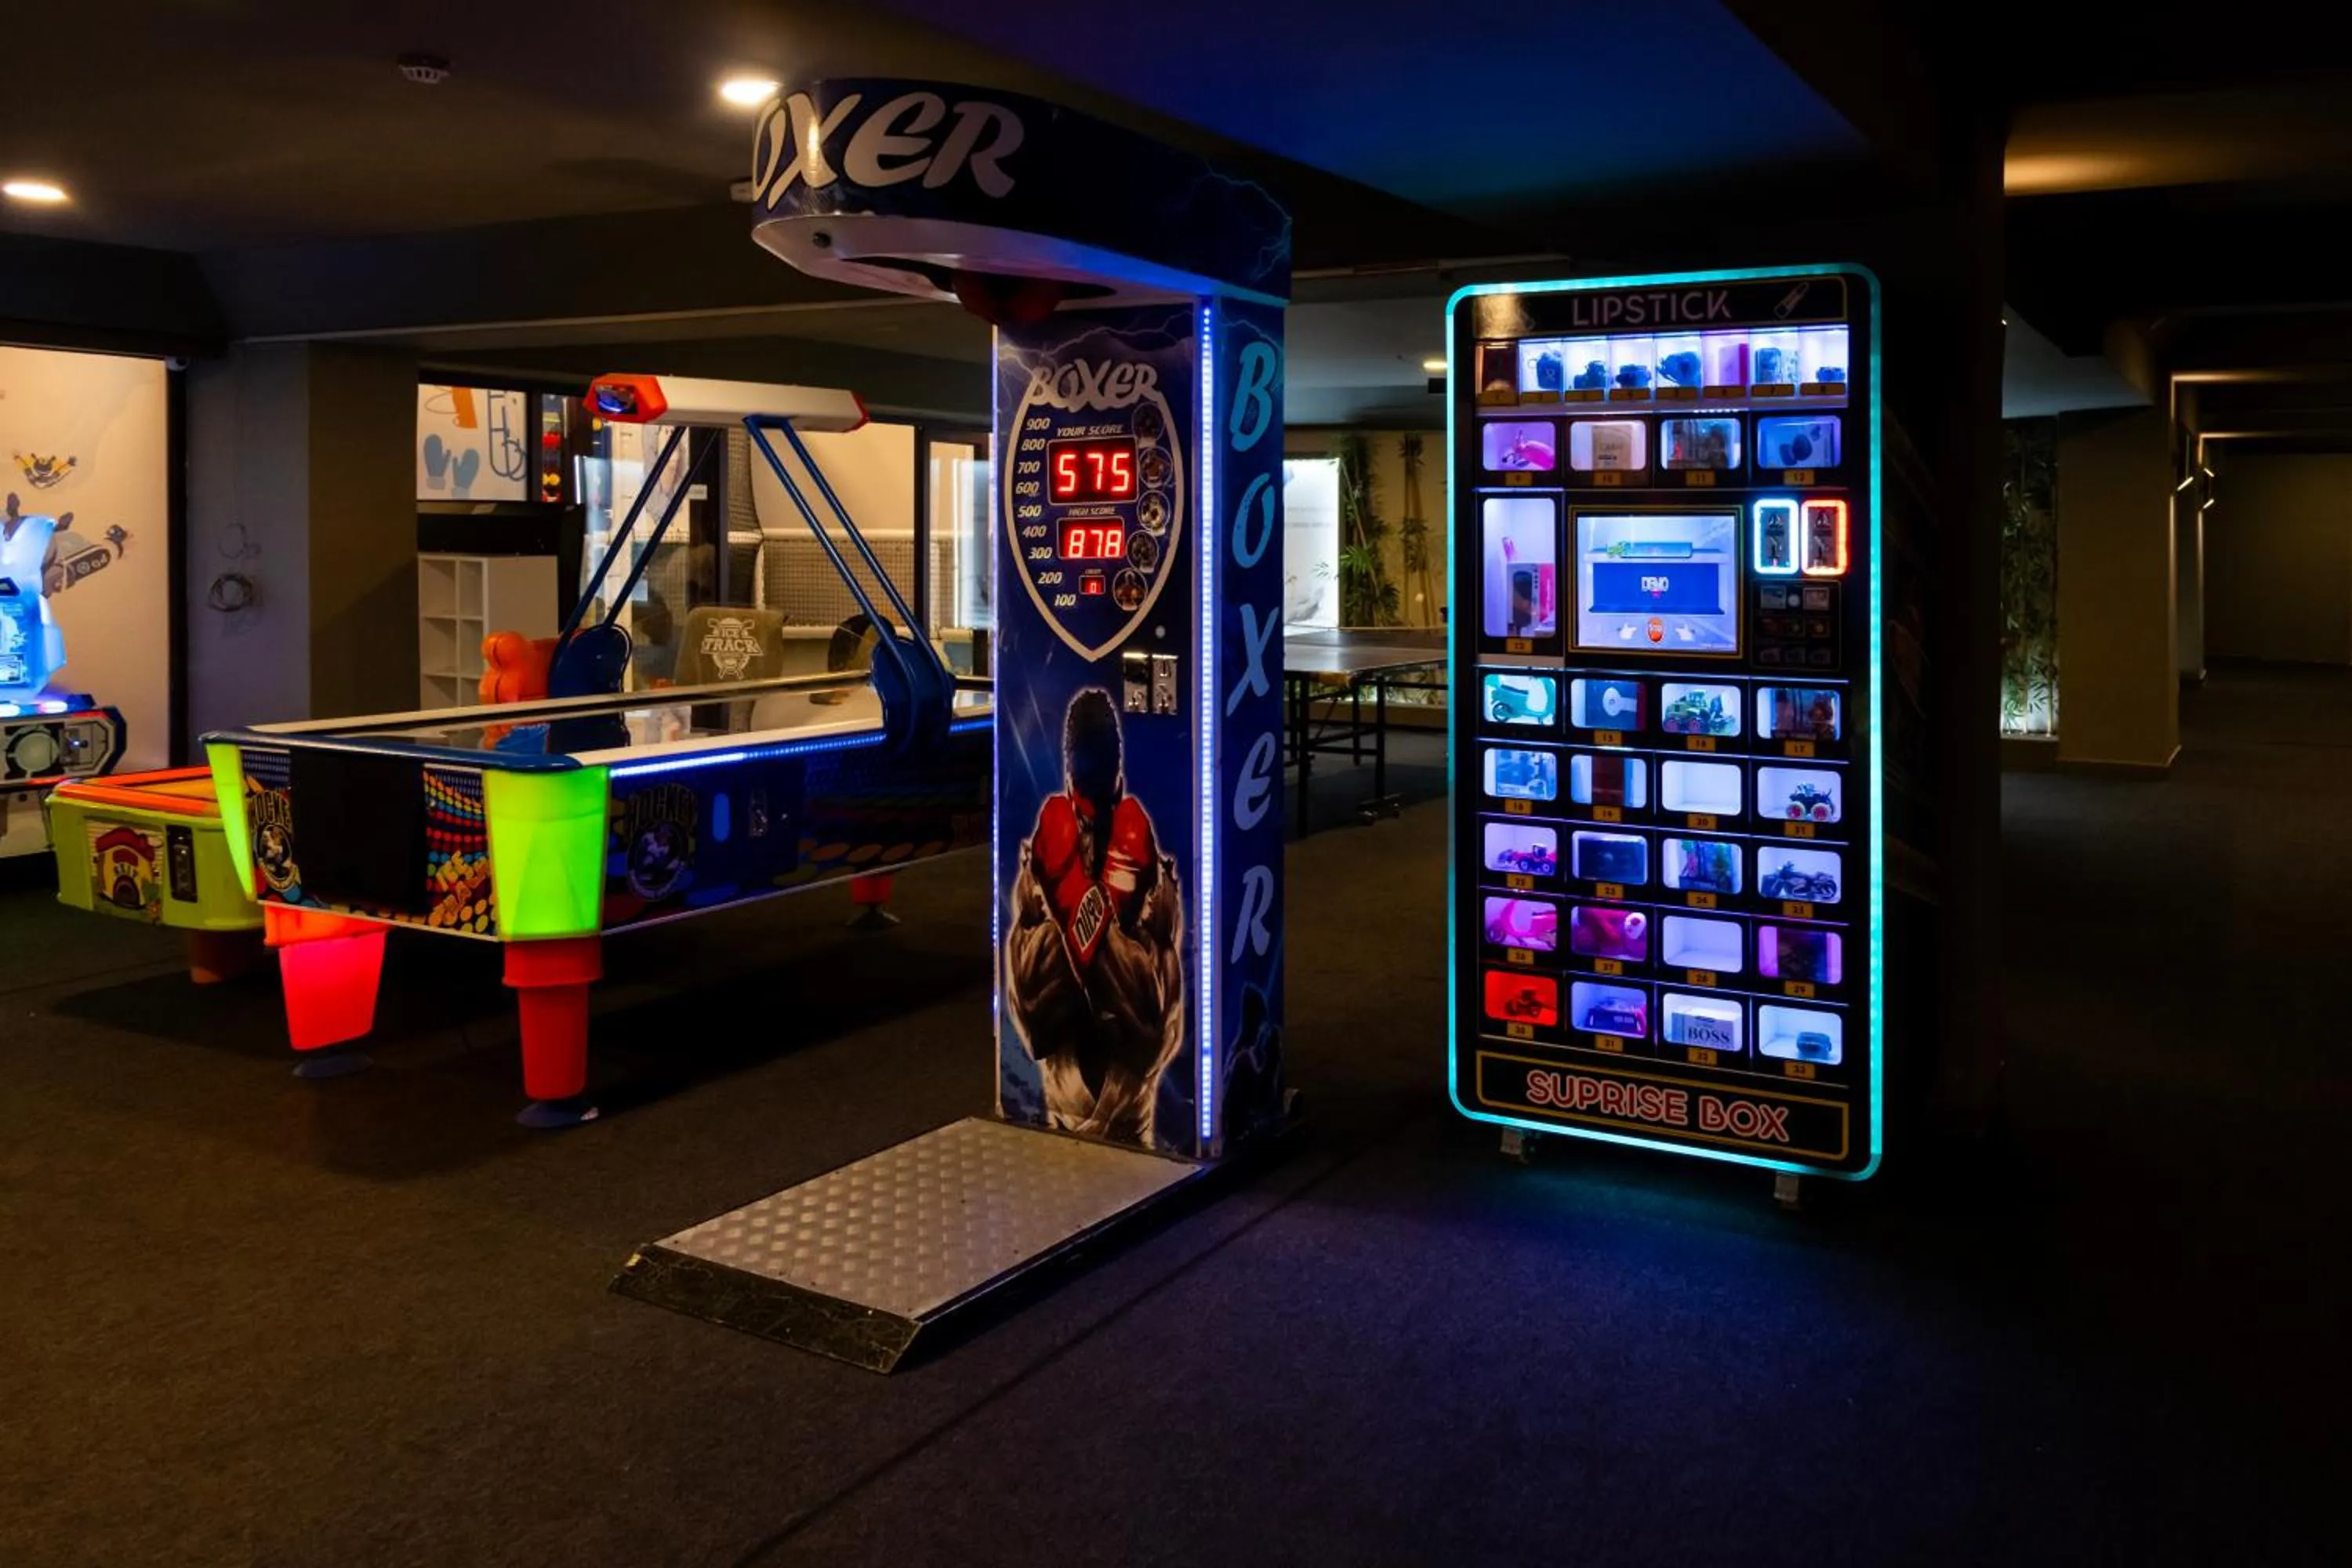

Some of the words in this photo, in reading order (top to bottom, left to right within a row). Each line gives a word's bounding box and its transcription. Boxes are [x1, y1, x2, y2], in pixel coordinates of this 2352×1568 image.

[1572, 291, 1731, 326] LIPSTICK
[1026, 358, 1160, 413] BOXER
[1025, 418, 1051, 430] 900
[1057, 426, 1085, 437] YOUR
[1088, 424, 1123, 435] SCORE
[1022, 439, 1045, 451] 800
[1018, 462, 1040, 474] 700
[1058, 452, 1130, 492] 575
[1015, 481, 1040, 494] 600
[1018, 505, 1041, 517] 500
[1022, 525, 1047, 538] 400
[1069, 529, 1122, 558] 878
[1029, 547, 1052, 559] 300
[1038, 572, 1062, 584] 200
[1054, 594, 1076, 606] 100
[705, 638, 759, 653] TRACK
[1227, 341, 1279, 964] BOXER
[1688, 1027, 1730, 1043] BOSS
[1526, 1069, 1689, 1126] SUPRISE
[1699, 1095, 1790, 1142] BOX
